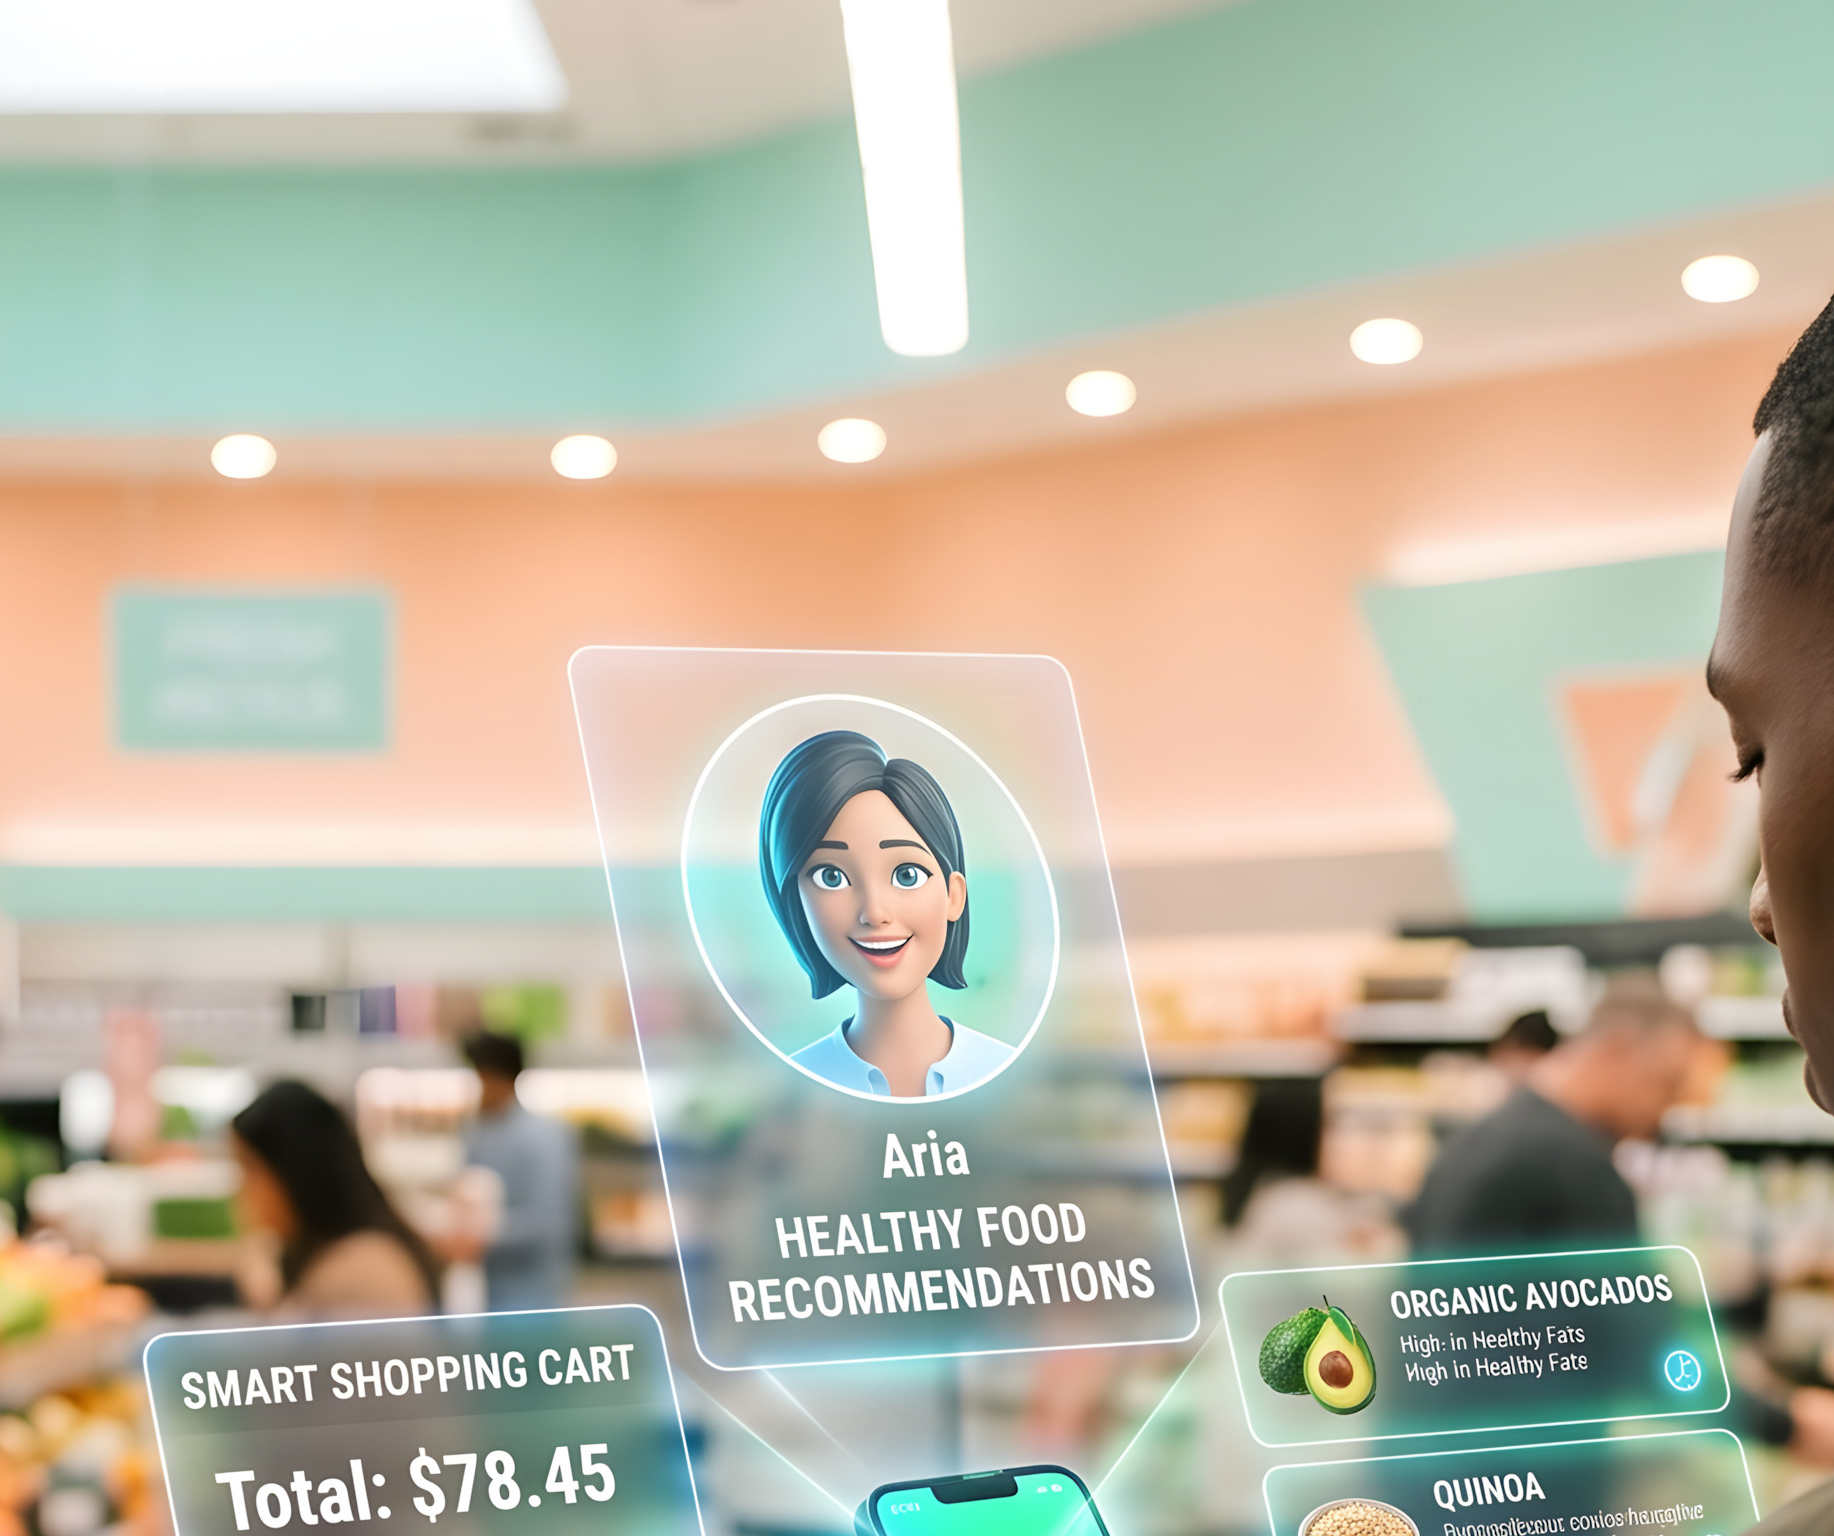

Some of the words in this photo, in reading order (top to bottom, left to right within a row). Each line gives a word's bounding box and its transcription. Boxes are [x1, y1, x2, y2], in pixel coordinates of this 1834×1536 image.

[882, 1129, 970, 1180] Aria
[775, 1208, 964, 1259] HEALTHY
[978, 1201, 1086, 1249] FOOD
[728, 1256, 1156, 1322] RECOMMENDATIONS
[1390, 1283, 1517, 1319] ORGANIC
[1526, 1273, 1673, 1311] AVOCADOS
[1450, 1332, 1467, 1351] in
[1453, 1359, 1471, 1379] in
[1476, 1355, 1543, 1378] Healthy
[180, 1364, 318, 1409] SMART
[330, 1349, 528, 1400] SHOPPING
[538, 1343, 635, 1387] CART
[215, 1458, 392, 1532] Total:
[409, 1442, 617, 1524] $78.45
[1434, 1471, 1546, 1512] QUINOA
